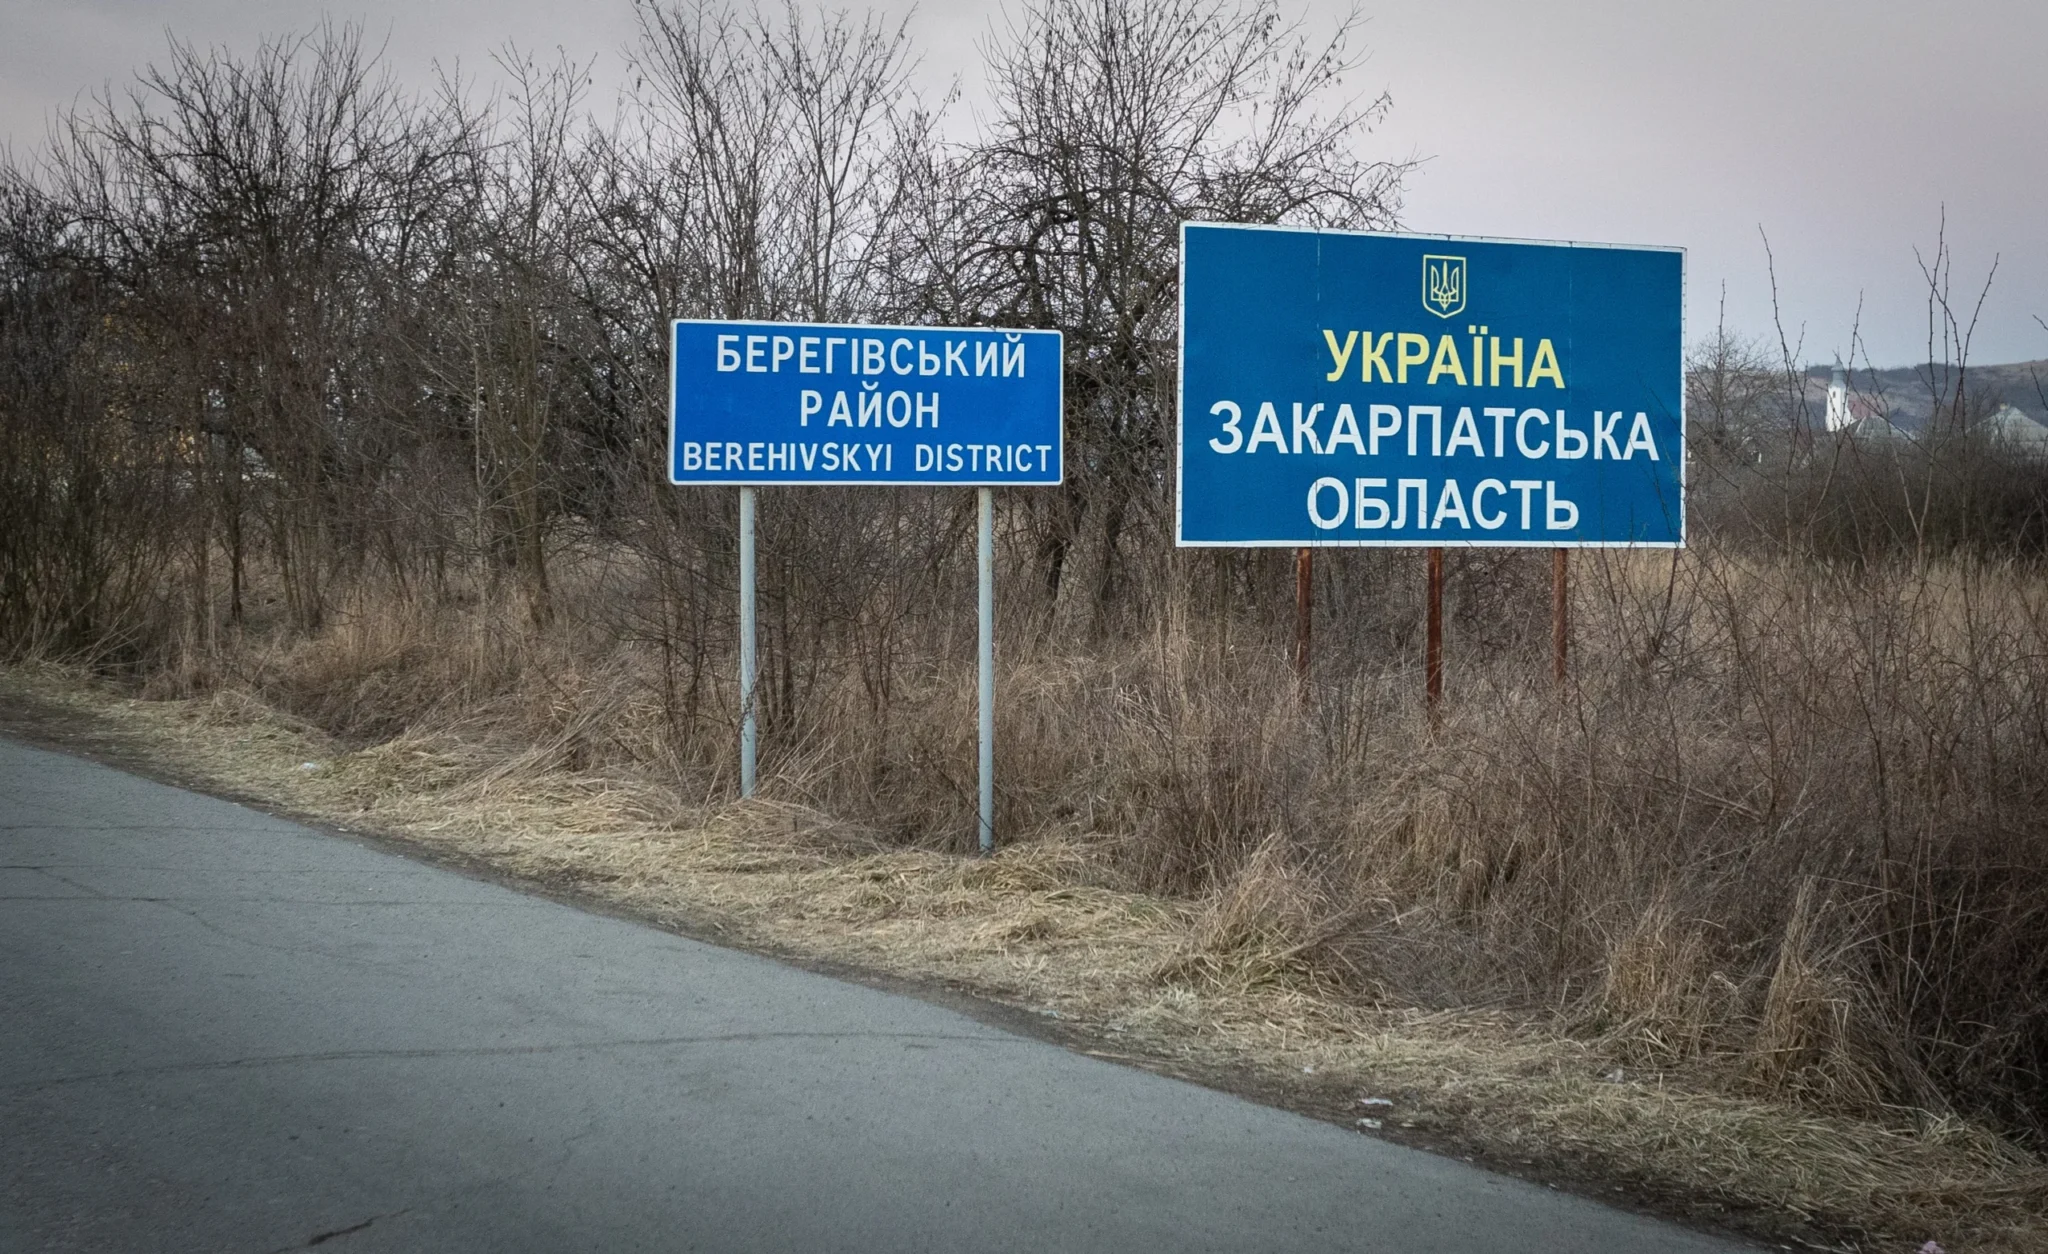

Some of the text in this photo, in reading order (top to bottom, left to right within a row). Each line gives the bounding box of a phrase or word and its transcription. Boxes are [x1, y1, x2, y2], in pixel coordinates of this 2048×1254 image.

[717, 334, 1026, 378] БЕРЕГІВСЬКИЙ
[1322, 325, 1565, 390] УКРАЇНА
[800, 381, 940, 428] РАЙОН
[1209, 400, 1660, 461] ЗАКАРПАТСЬКА
[683, 442, 1053, 473] BEREHIVSKYI DISTRICT
[1307, 476, 1579, 531] ОБЛАСТЬ
